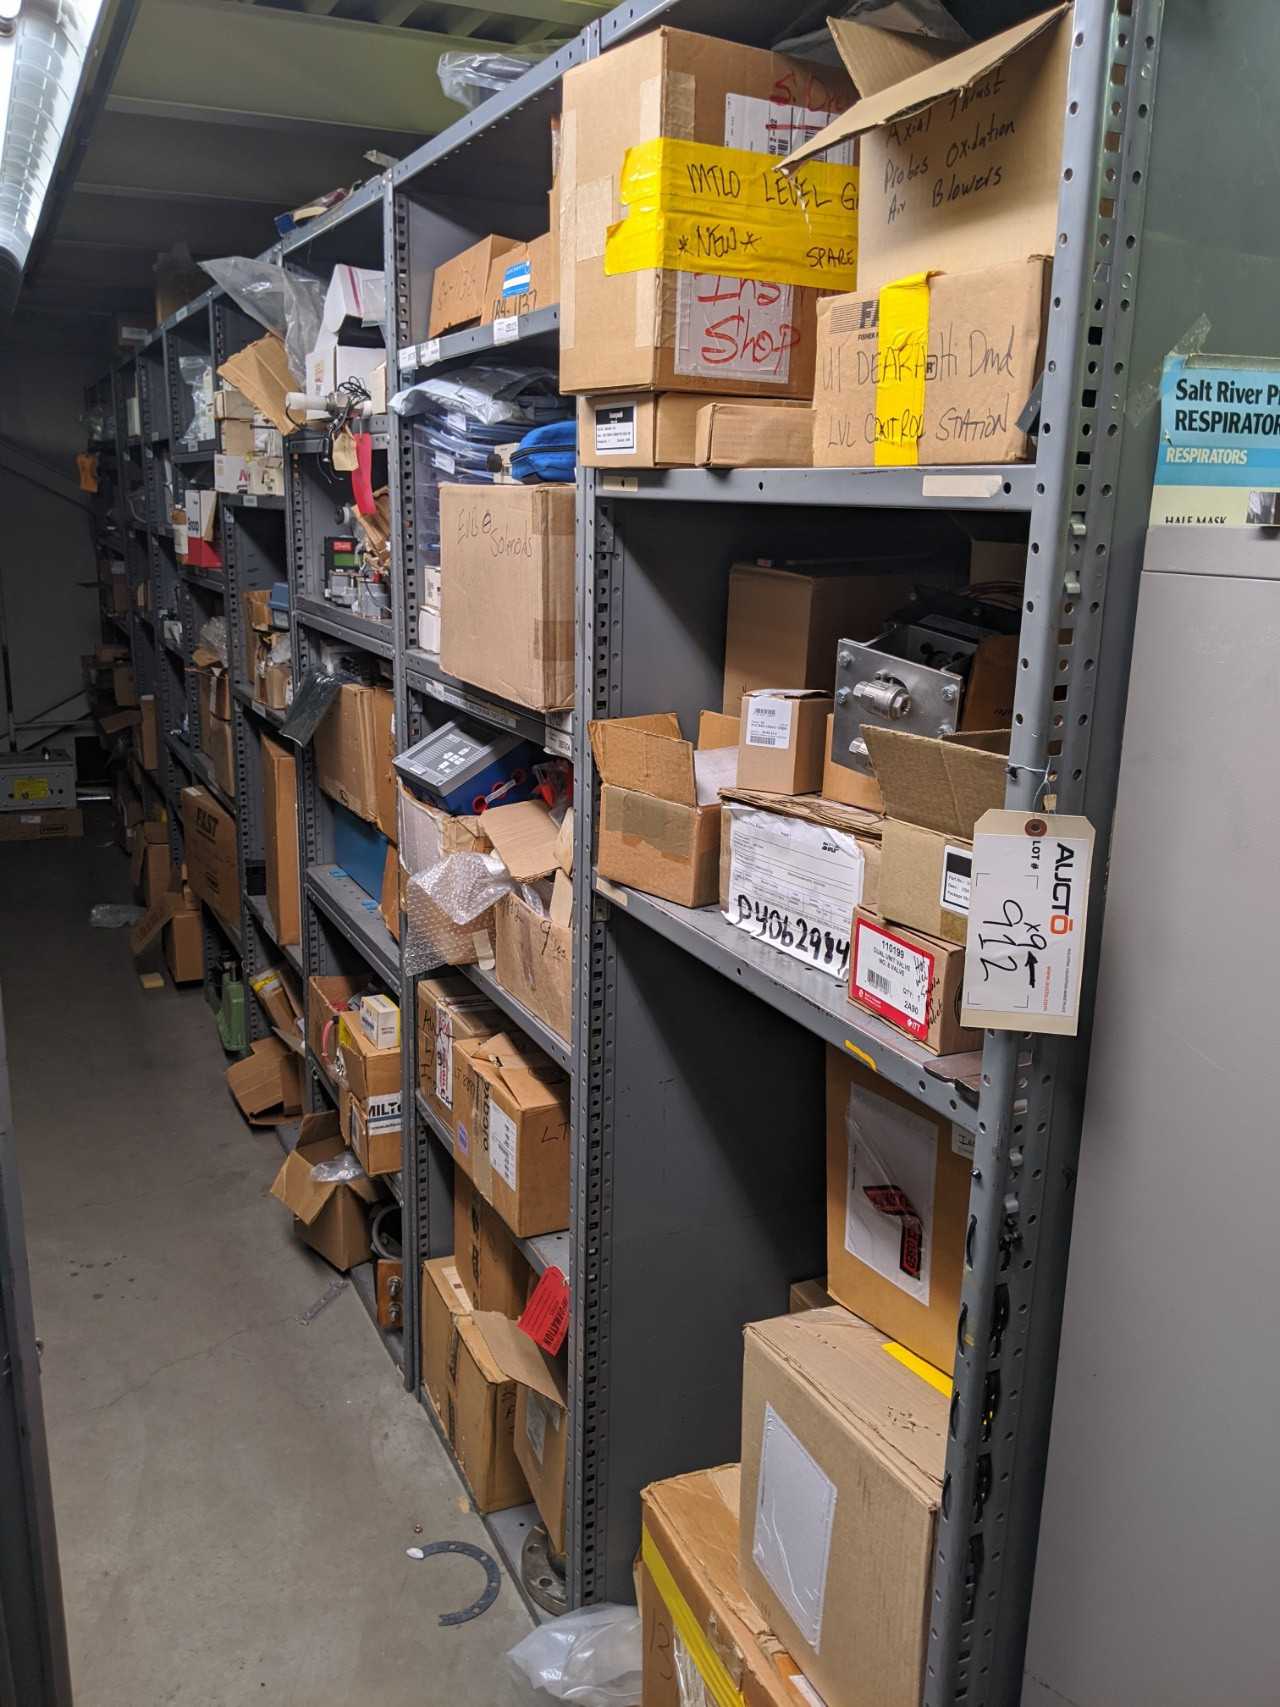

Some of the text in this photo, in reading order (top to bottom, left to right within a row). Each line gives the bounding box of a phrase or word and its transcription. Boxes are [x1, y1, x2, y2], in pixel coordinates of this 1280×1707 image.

[763, 172, 832, 209] LEVEL
[884, 153, 929, 194] Probes
[931, 166, 1002, 208] Blowers
[806, 246, 856, 269] SPARE
[1175, 378, 1213, 402] Salt
[1217, 380, 1263, 406] River
[935, 392, 1010, 441] STATION
[1165, 446, 1249, 465] RESPIRATORS
[1032, 840, 1041, 861] LOT
[978, 899, 1024, 982] 912
